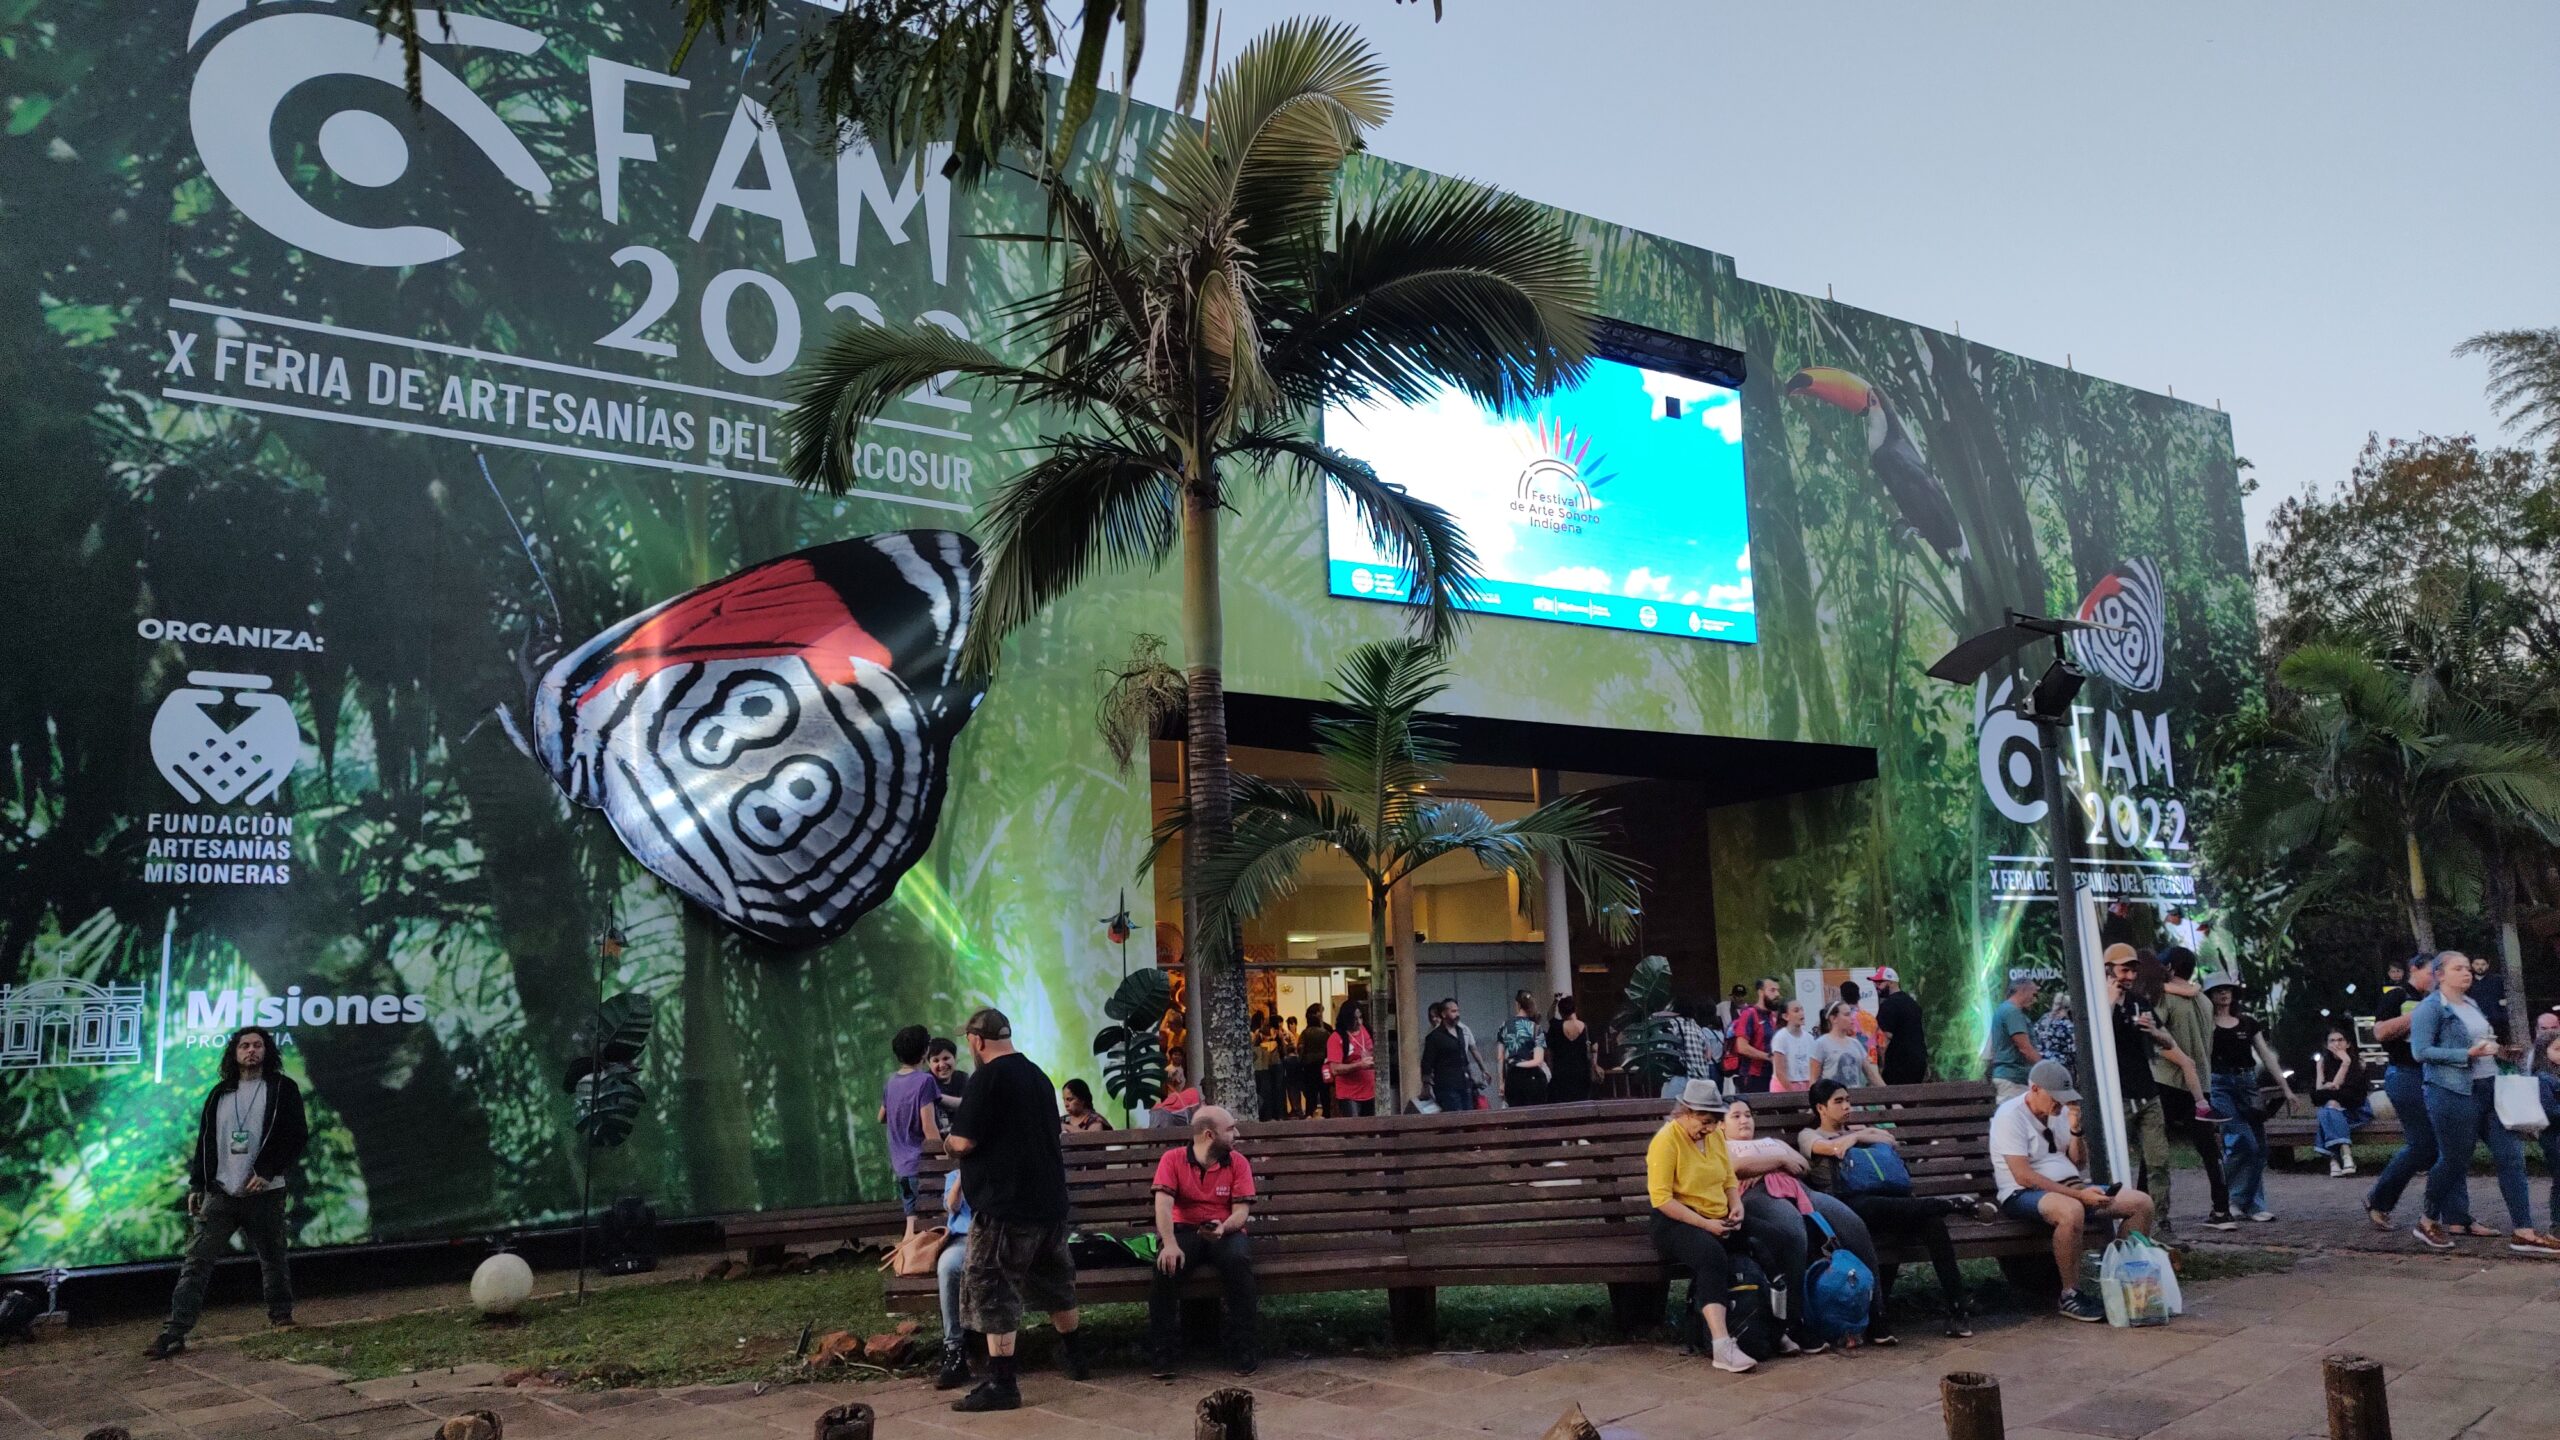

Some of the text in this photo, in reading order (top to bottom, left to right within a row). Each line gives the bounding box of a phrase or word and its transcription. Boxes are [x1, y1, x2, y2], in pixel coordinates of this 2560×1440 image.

[587, 55, 953, 286] FAM
[164, 329, 198, 377] X
[214, 337, 351, 400] FERIA
[368, 362, 426, 411] DE
[438, 376, 695, 451] ARTESANÍAS
[709, 416, 778, 464] DEL
[1531, 490, 1578, 507] Festival
[1510, 501, 1600, 524] de Arte Sonoro
[138, 618, 324, 652] ORGANIZA:
[2071, 705, 2175, 789] FAM
[148, 812, 292, 836] FUNDACIÓN
[2085, 791, 2190, 850] 2022
[146, 836, 291, 860] ARTESANÍAS
[144, 863, 290, 884] MISIONERAS
[1990, 869, 1999, 890] X
[2001, 869, 2036, 891] FERIA
[2036, 870, 2052, 891] DE
[2120, 873, 2141, 893] DEL
[187, 986, 427, 1029] Misiones
[186, 1032, 293, 1048] PROIA
